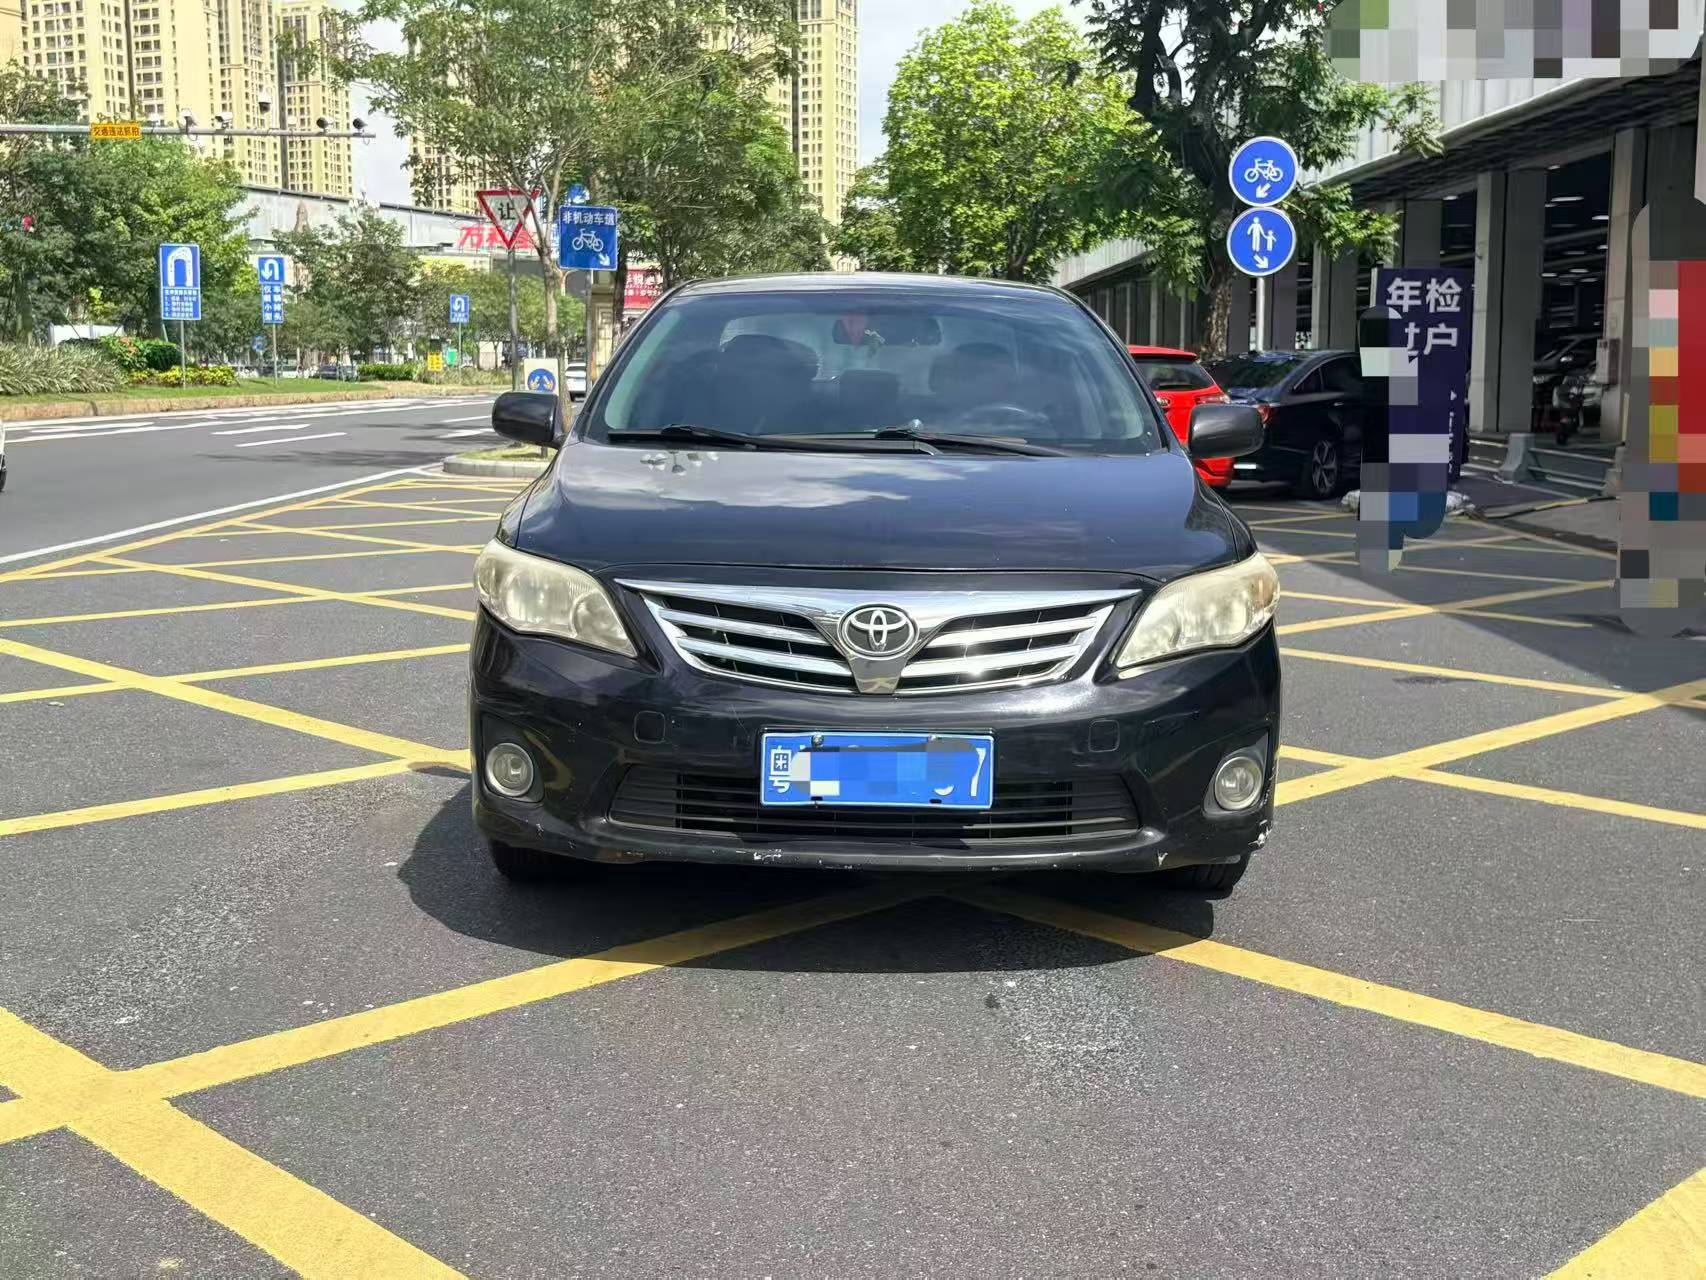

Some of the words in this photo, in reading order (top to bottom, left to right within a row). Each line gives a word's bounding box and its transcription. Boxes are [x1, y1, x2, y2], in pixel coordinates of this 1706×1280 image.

[498, 202, 516, 220] 让
[562, 210, 615, 226] 非机动车道
[1386, 277, 1462, 313] 年检
